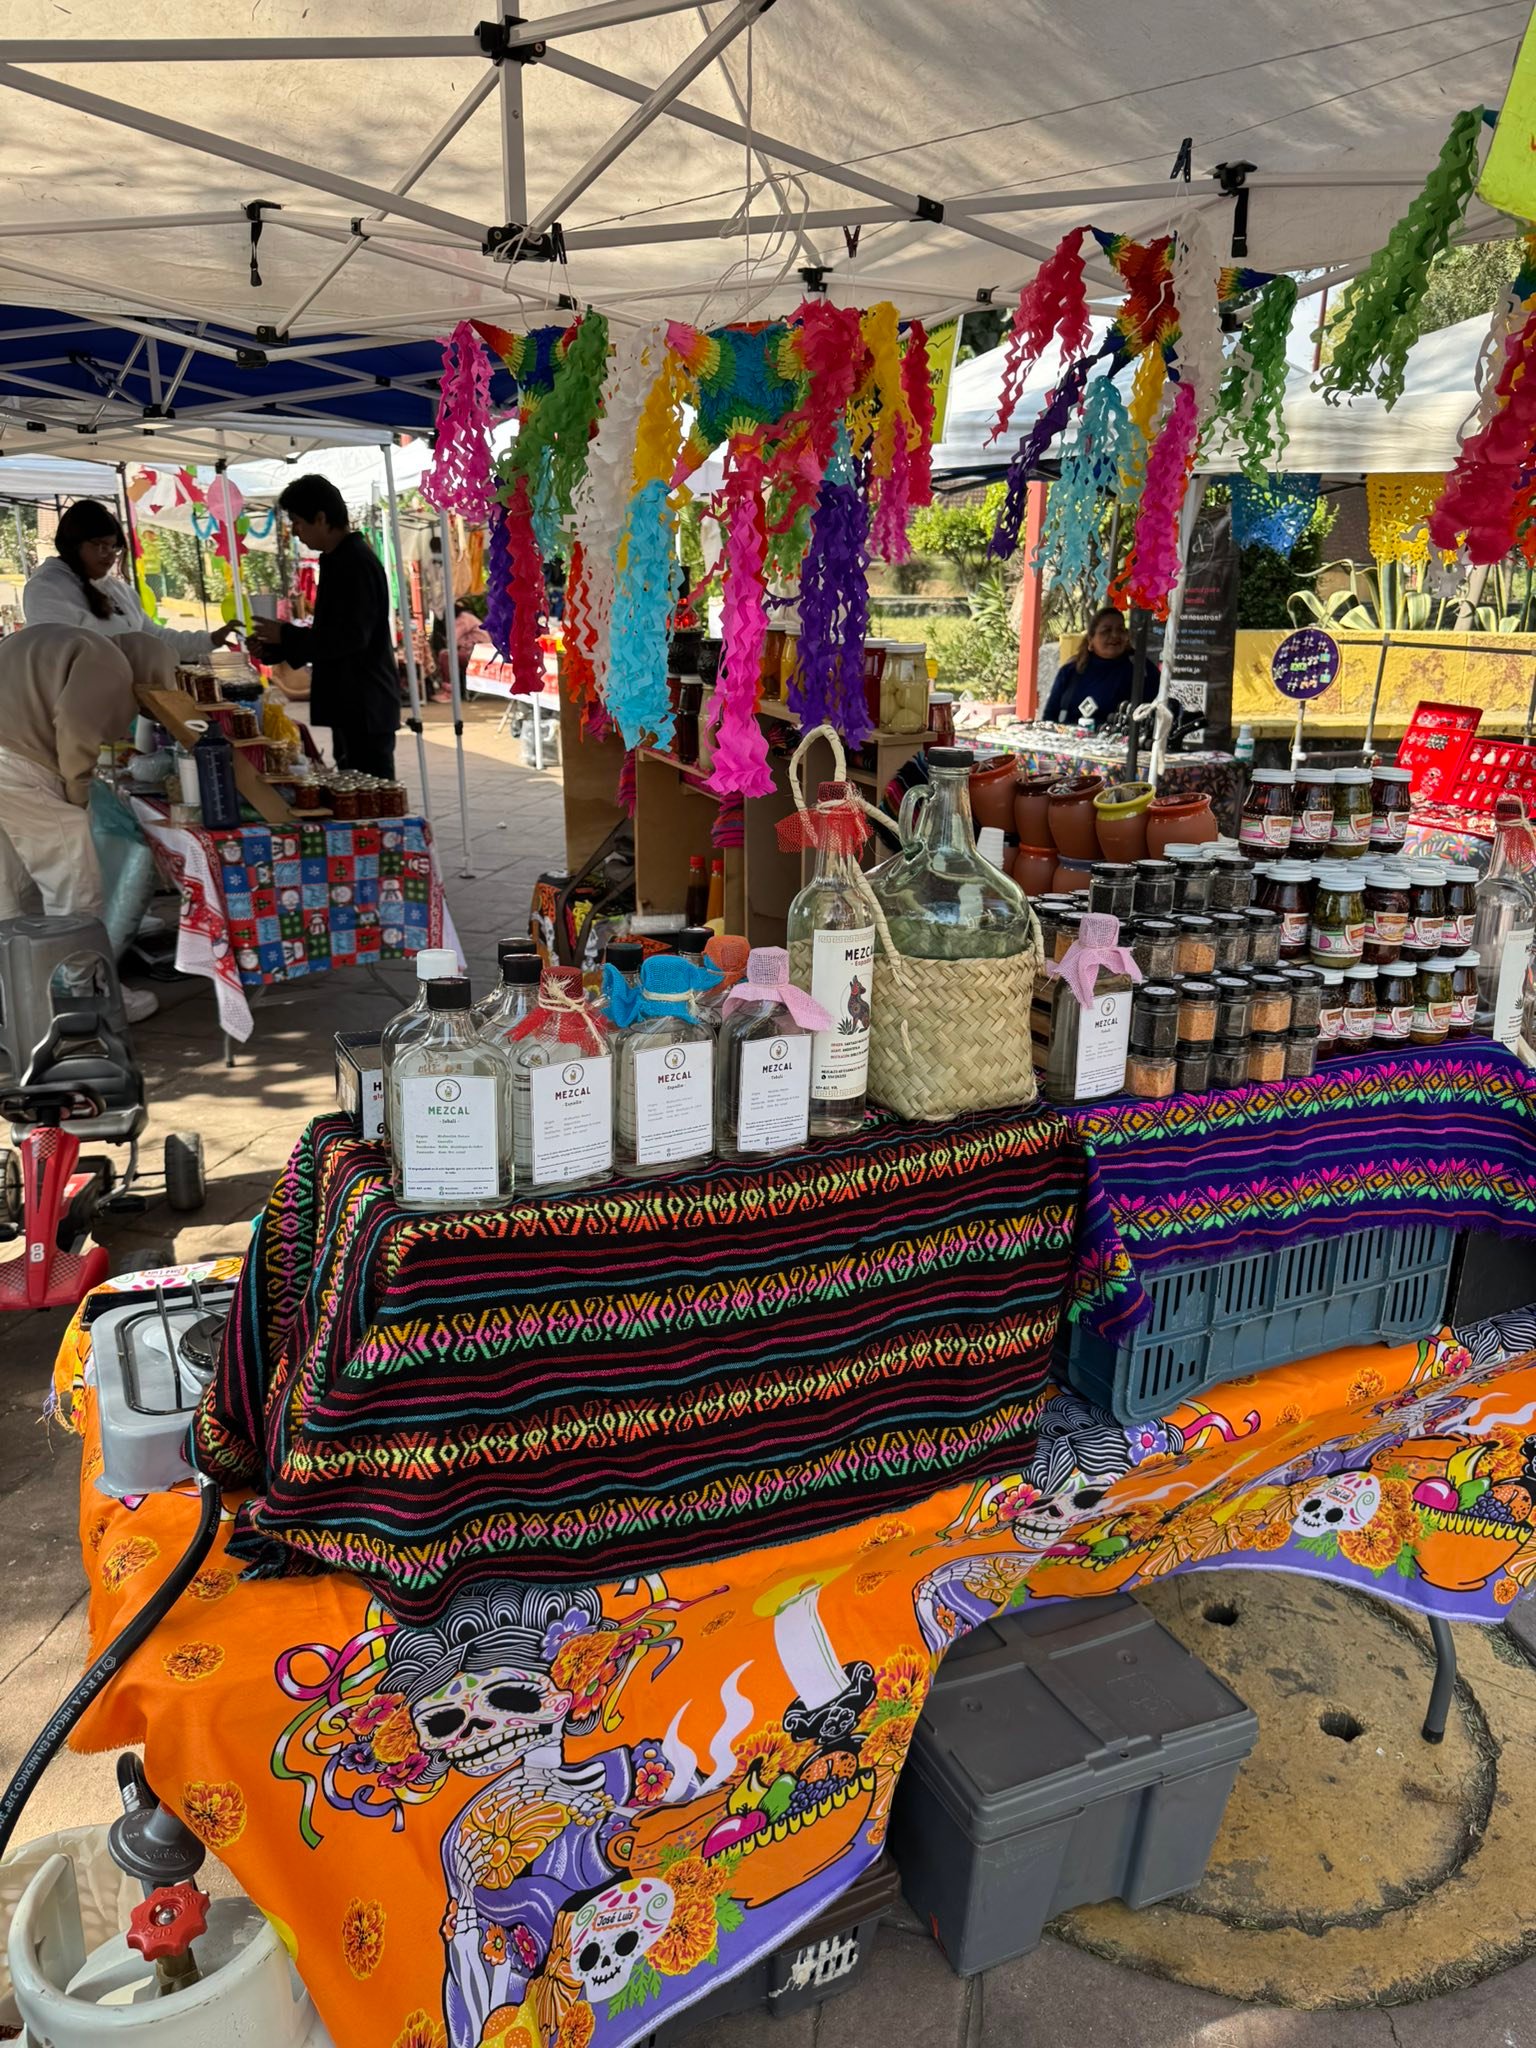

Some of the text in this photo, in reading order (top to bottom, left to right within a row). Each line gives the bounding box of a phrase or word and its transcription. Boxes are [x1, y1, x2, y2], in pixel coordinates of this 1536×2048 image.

[845, 945, 873, 961] MEZC
[1095, 1017, 1119, 1029] MEZCAL
[762, 1061, 793, 1074] MEZCAL
[657, 1070, 692, 1084] MEZCAL
[554, 1086, 592, 1101] MEZCAL
[428, 1106, 471, 1115] MEZCAL
[30, 1242, 45, 1263] 8
[75, 1669, 105, 1707] ERSA
[50, 1706, 75, 1742] HECHO
[37, 1741, 52, 1753] EN
[14, 1754, 42, 1792] MEXICO
[597, 1909, 634, 1927] José Luis
